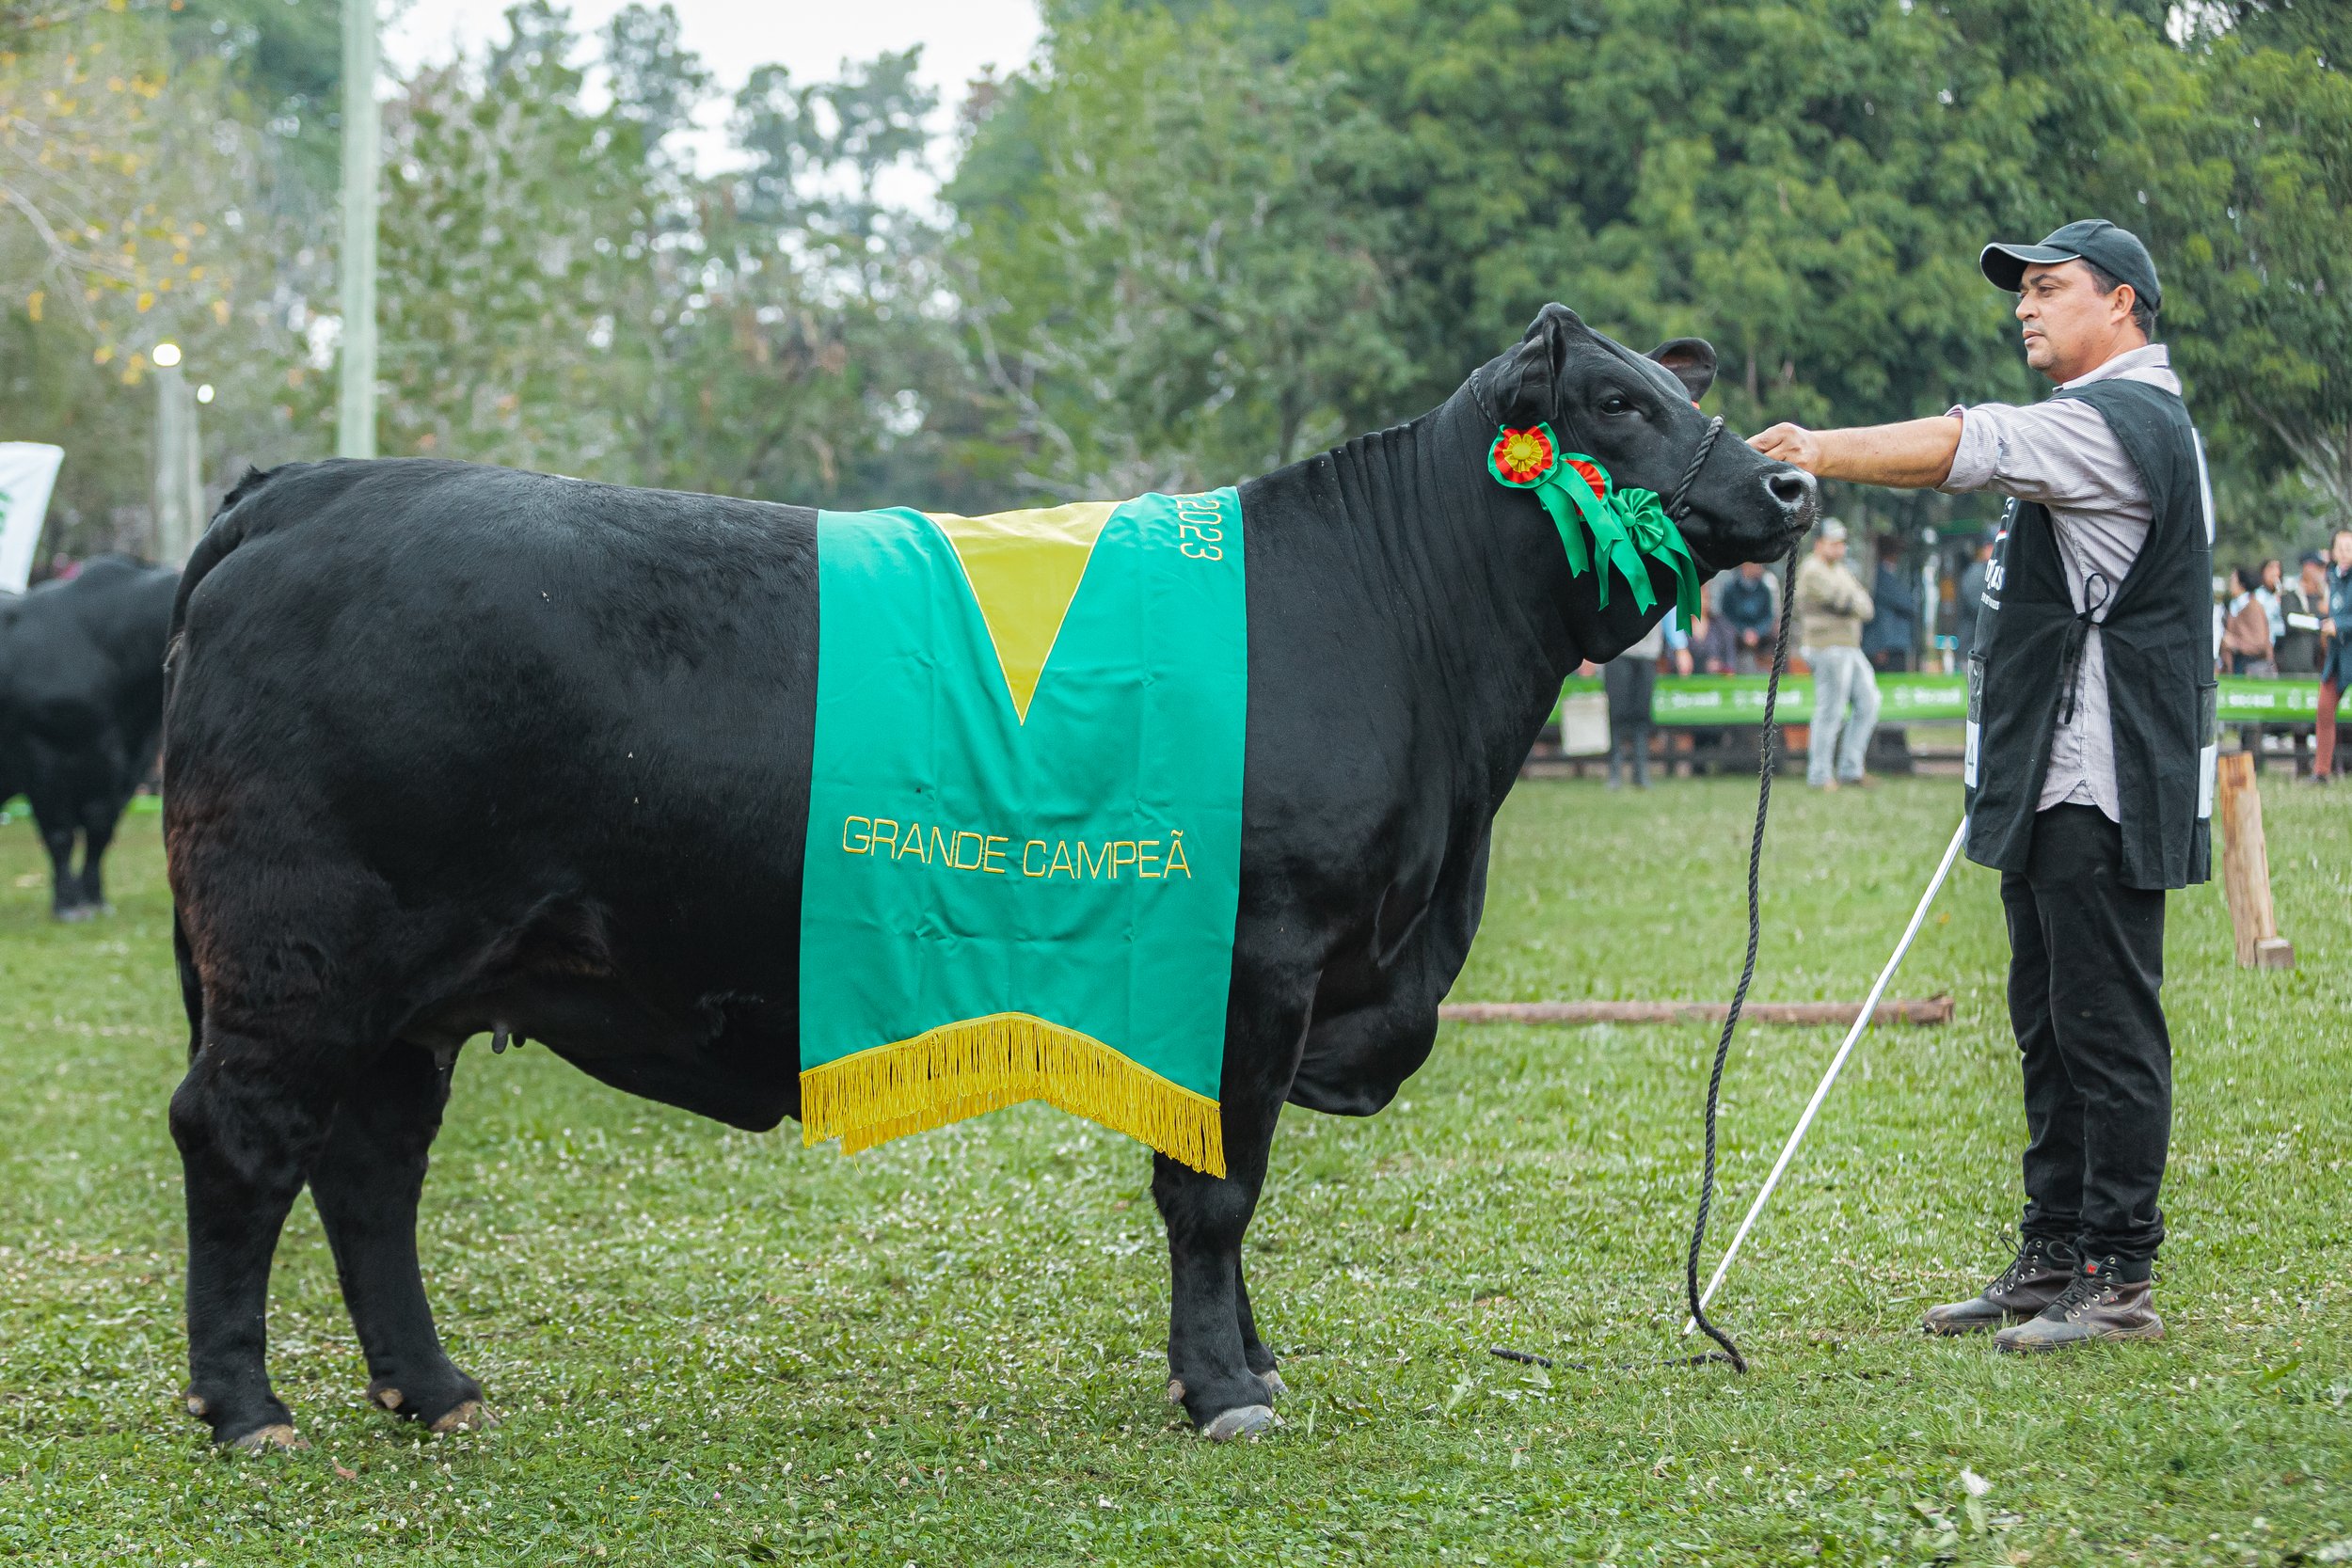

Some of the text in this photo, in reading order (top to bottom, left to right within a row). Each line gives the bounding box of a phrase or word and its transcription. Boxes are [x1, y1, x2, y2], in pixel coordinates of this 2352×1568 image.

[1176, 499, 1223, 561] 2023
[842, 816, 1192, 879] GRANDE CAMPEÃ
